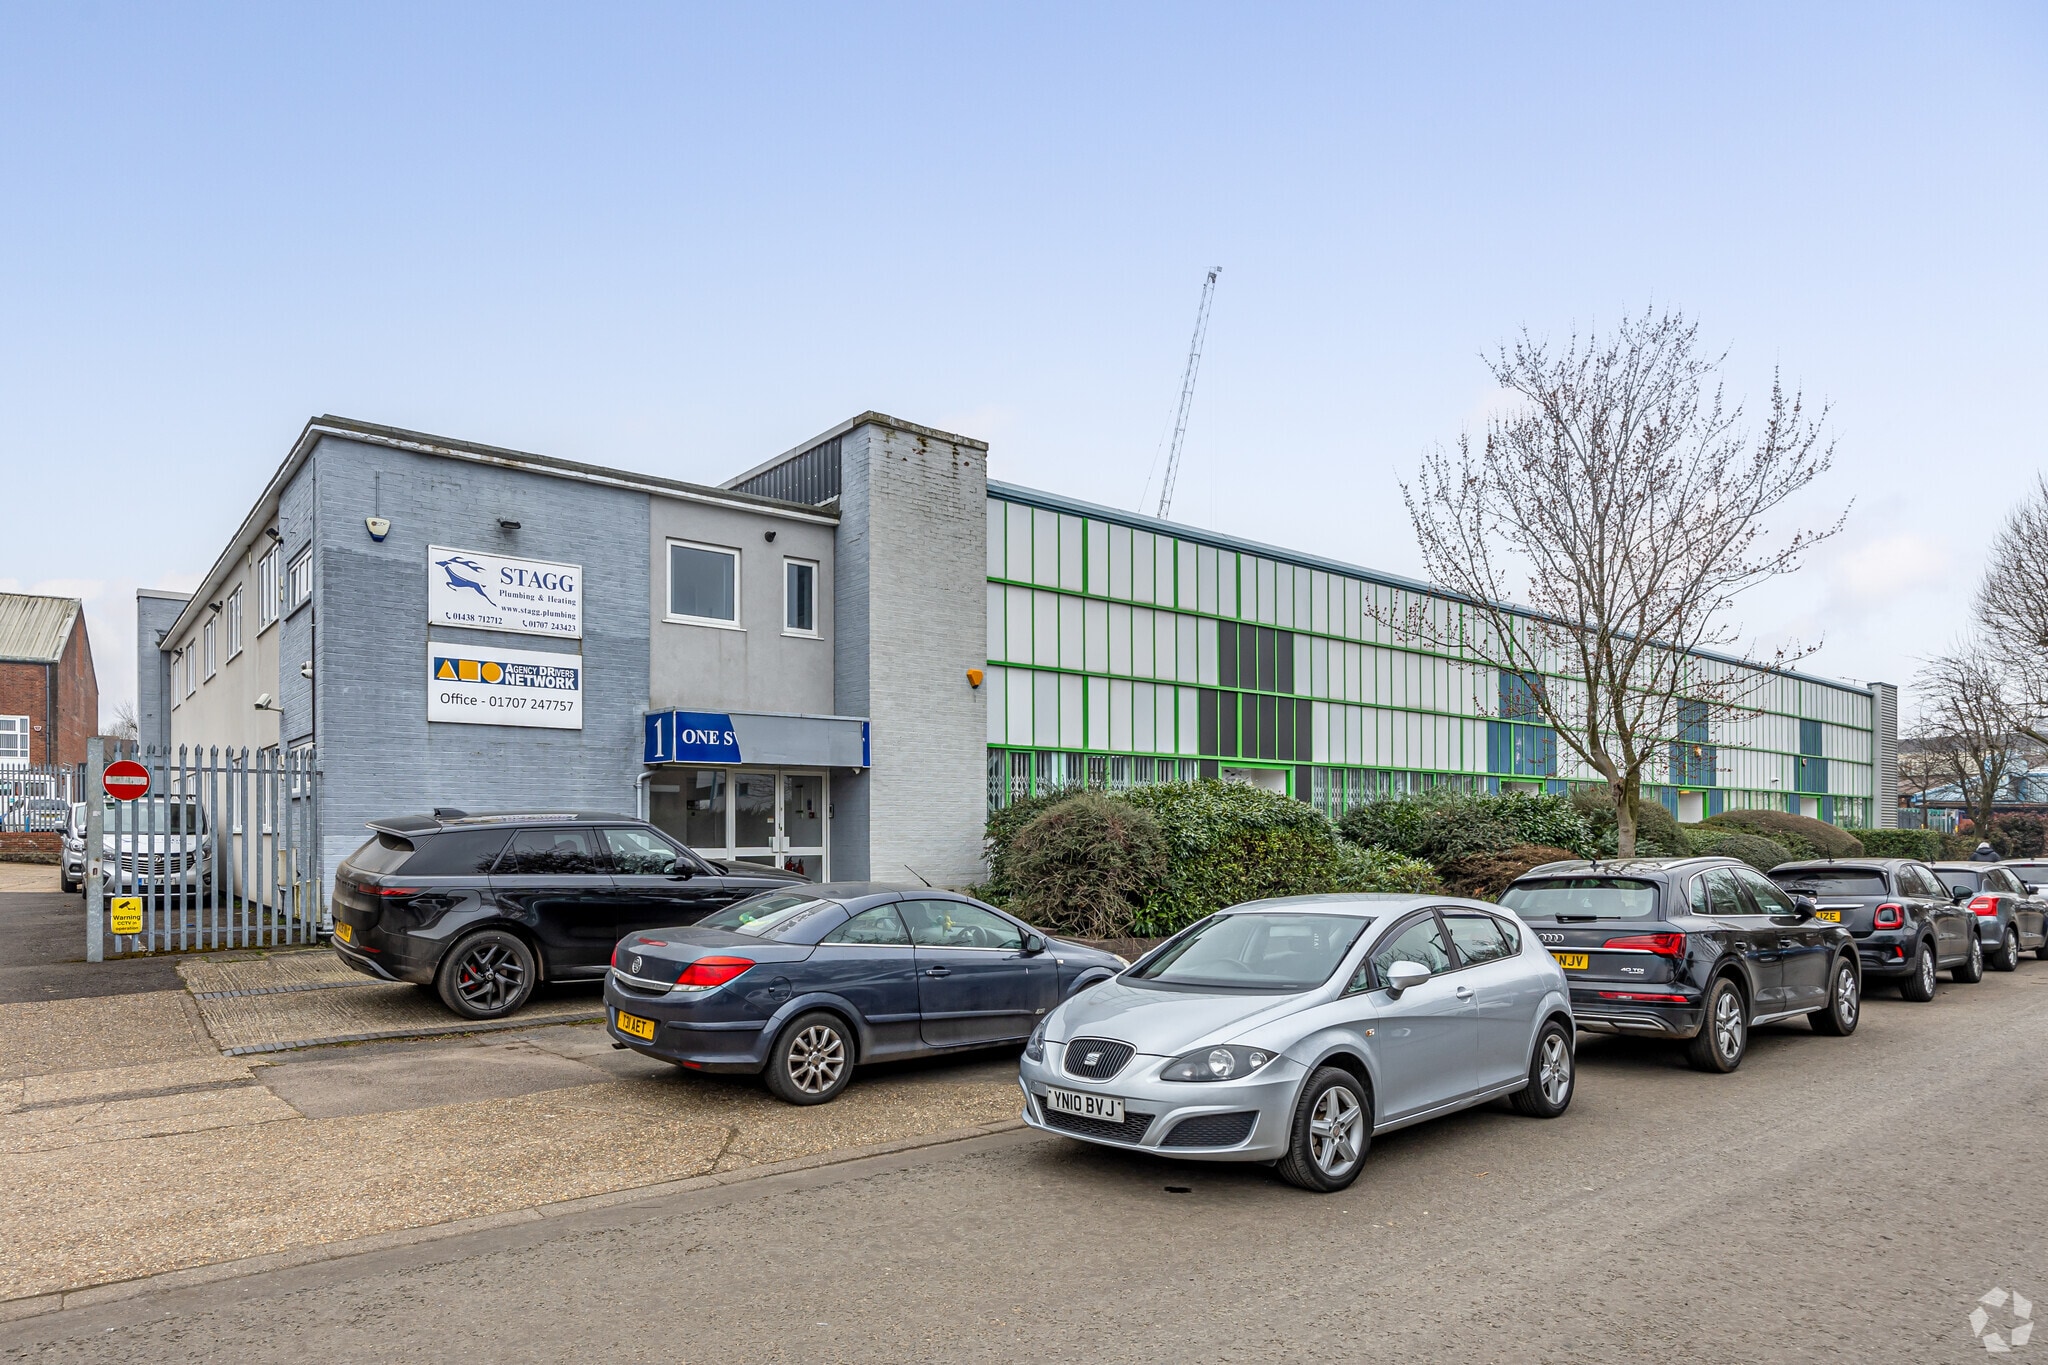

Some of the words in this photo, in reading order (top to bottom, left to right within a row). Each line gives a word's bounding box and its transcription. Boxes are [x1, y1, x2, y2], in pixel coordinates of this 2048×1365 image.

[500, 566, 574, 592] STAGG
[500, 589, 535, 601] Plumbing
[548, 595, 576, 606] Heating
[452, 612, 475, 622] 01438
[478, 615, 503, 625] 712712
[501, 605, 576, 620] www.stagg.plumbing
[528, 620, 548, 629] 01707
[551, 622, 576, 632] 243423
[505, 663, 537, 675] AGENCY
[539, 666, 574, 678] DRIVERS
[504, 674, 575, 690] NETWORK
[440, 693, 478, 706] Office
[489, 696, 526, 709] 01707
[531, 699, 574, 712] 247757
[654, 718, 664, 758] 1
[682, 729, 720, 745] ONE
[723, 731, 736, 746] S
[631, 1018, 647, 1034] AET
[1054, 1090, 1081, 1111] YN10
[1086, 1097, 1114, 1117] BVJ
